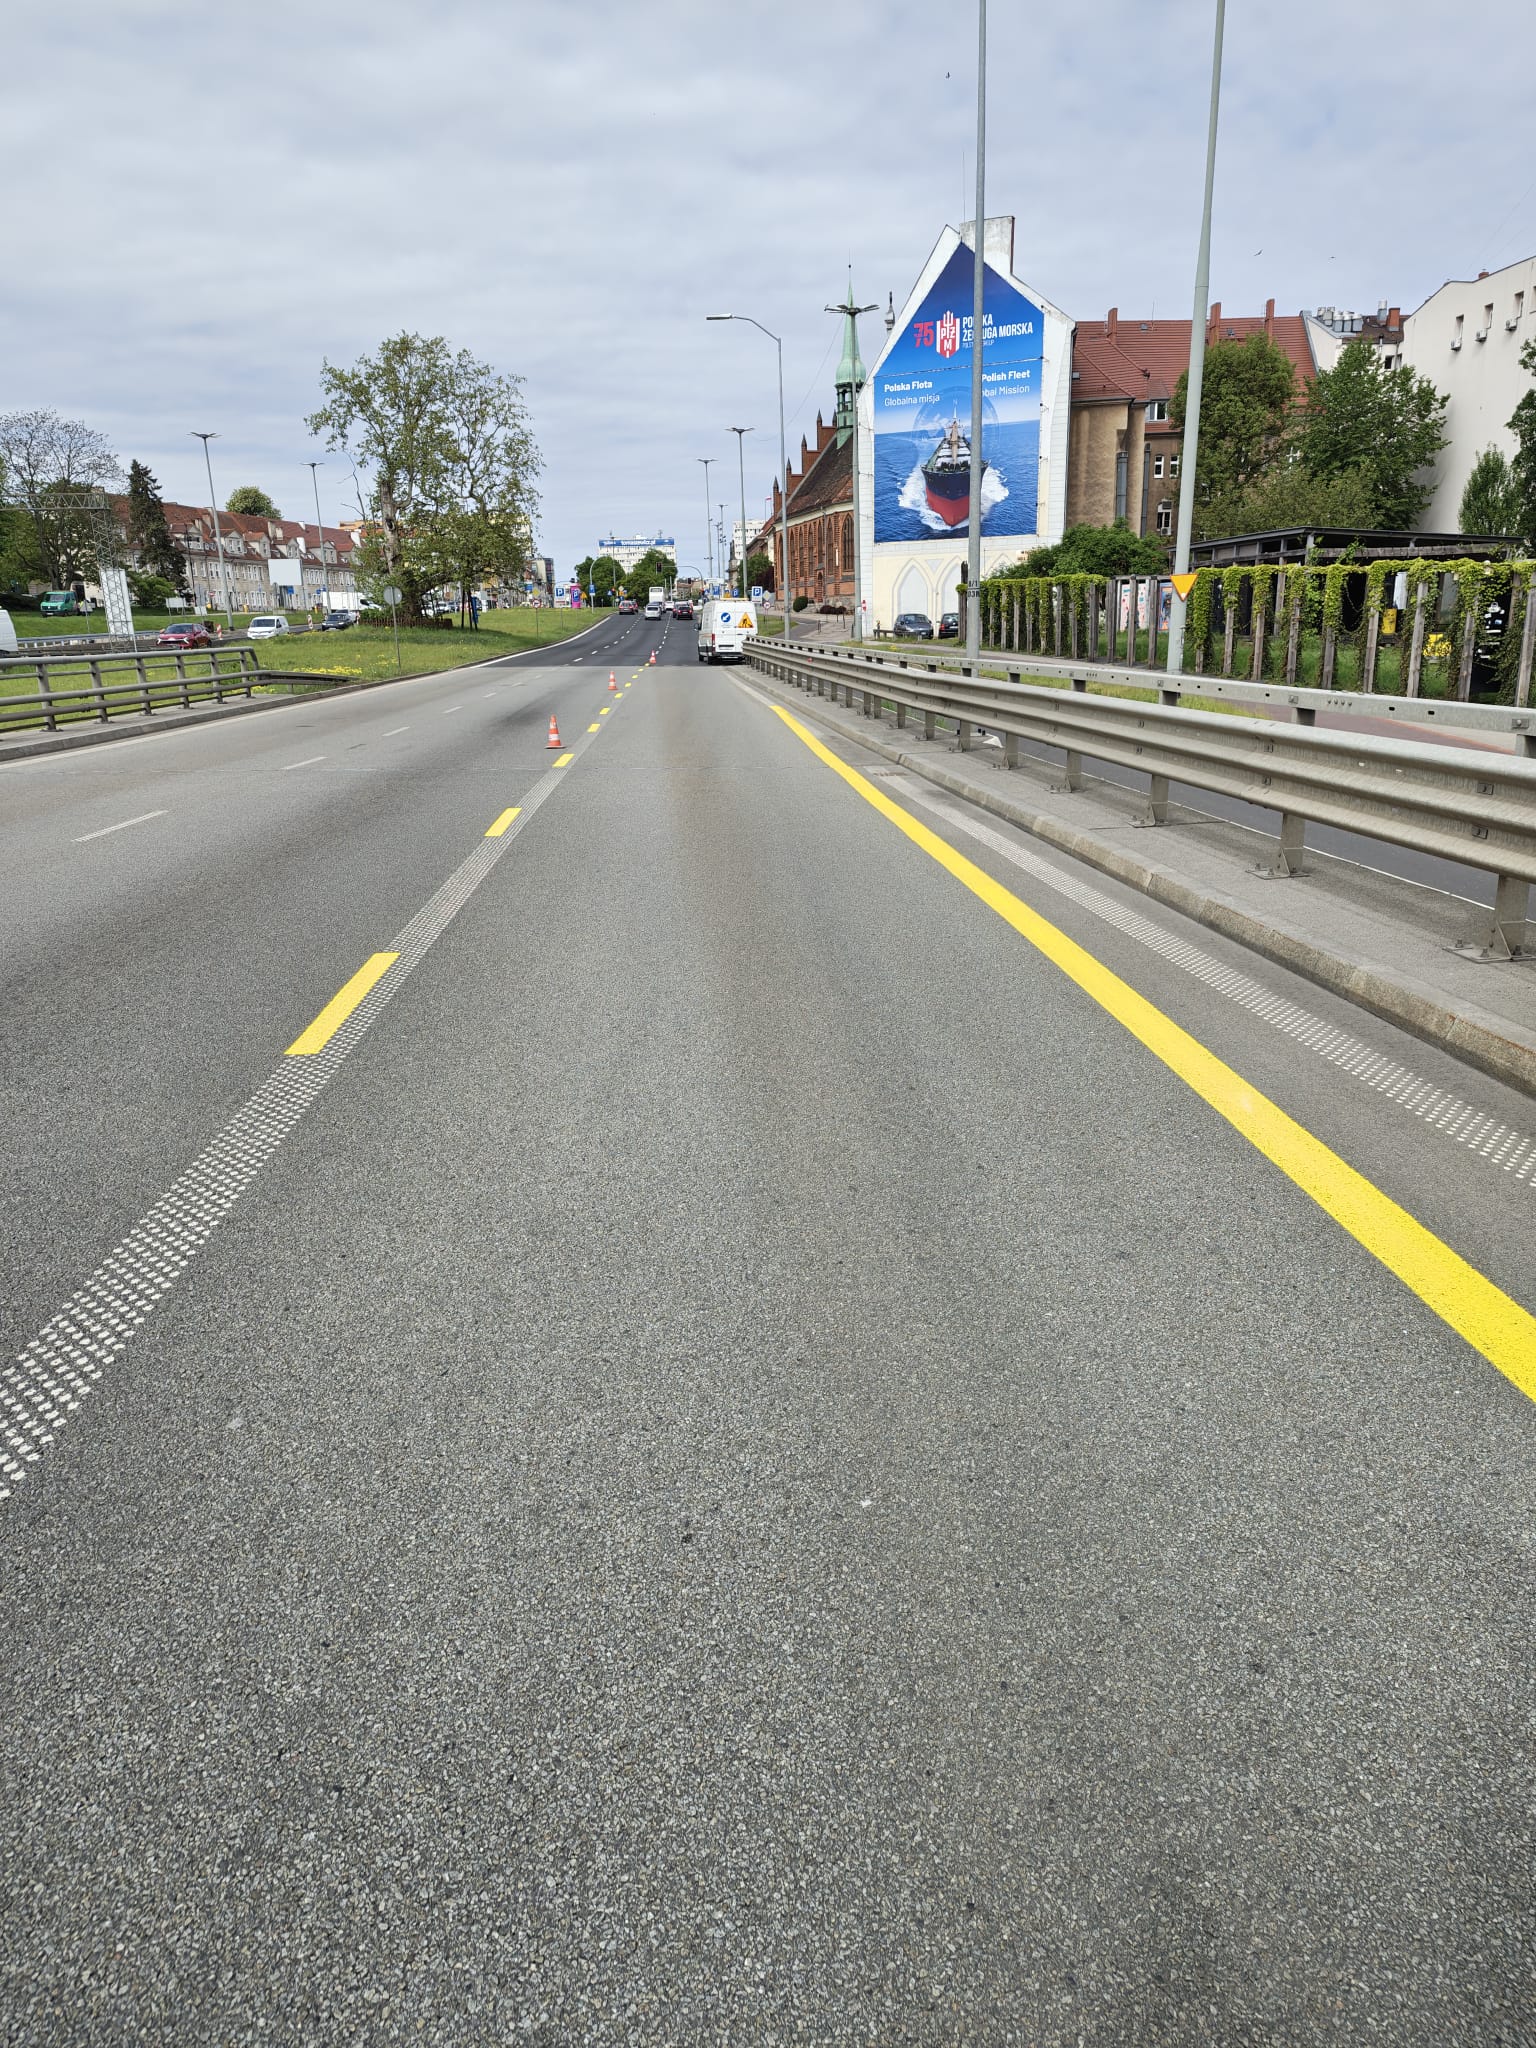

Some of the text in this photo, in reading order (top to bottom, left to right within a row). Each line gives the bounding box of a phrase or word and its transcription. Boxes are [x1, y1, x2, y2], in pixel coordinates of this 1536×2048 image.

[914, 321, 934, 348] 75
[999, 321, 1034, 337] MORSKA
[982, 370, 1030, 381] Polish Fleet
[884, 380, 933, 392] Polska Flota
[999, 385, 1030, 395] Mission
[884, 393, 940, 406] Globalna misja
